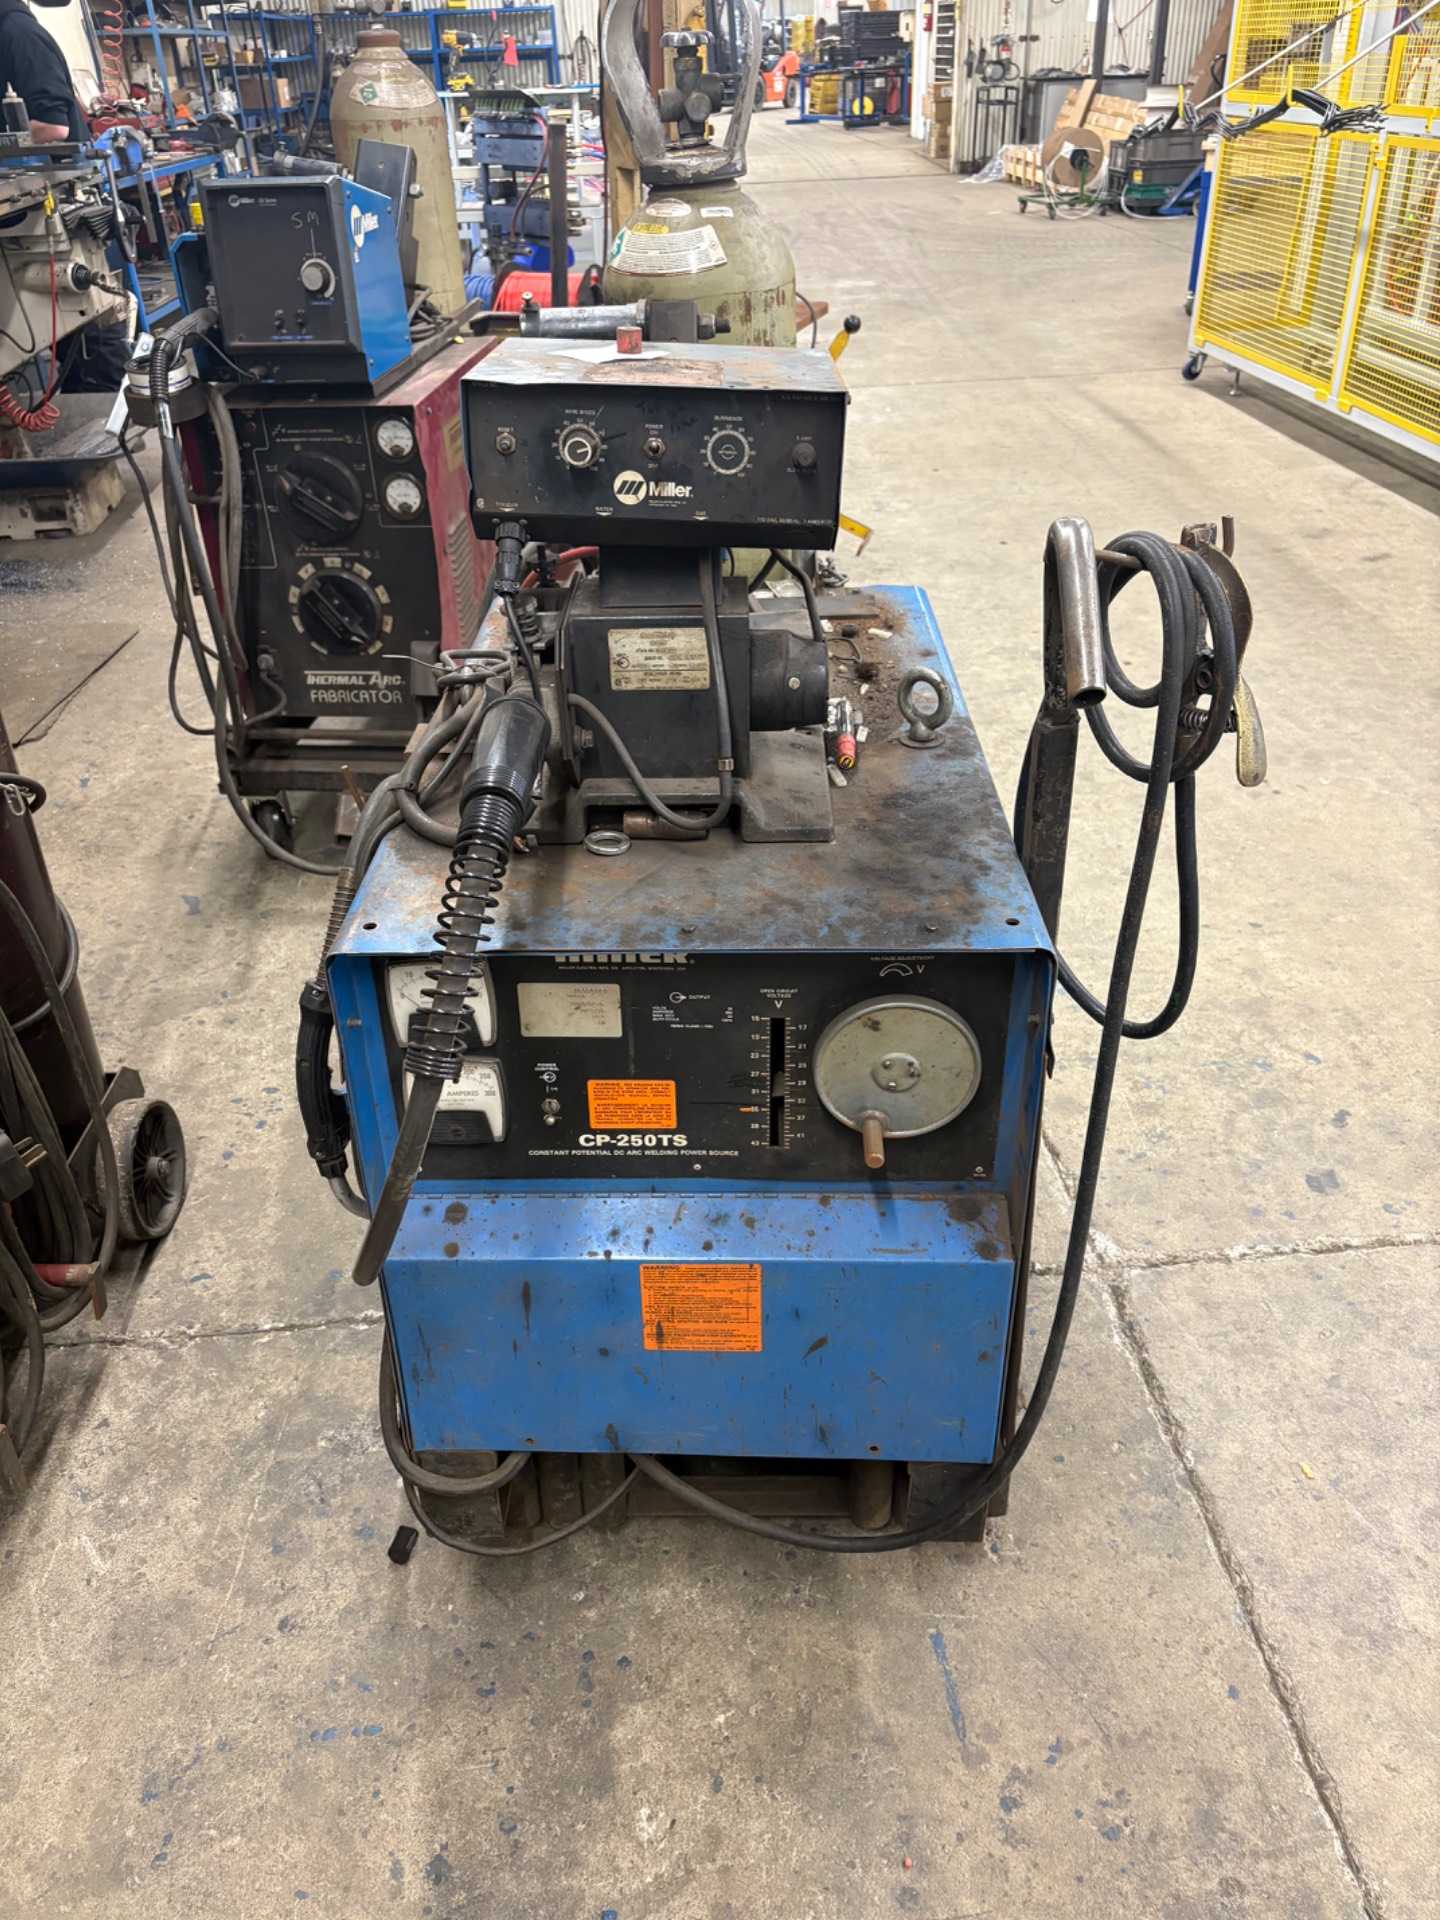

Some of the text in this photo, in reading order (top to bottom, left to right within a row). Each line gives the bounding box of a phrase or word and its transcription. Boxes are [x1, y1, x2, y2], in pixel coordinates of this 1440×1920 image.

[649, 481, 693, 497] Miller
[310, 690, 403, 703] FABRICATOR
[916, 965, 925, 974] V
[774, 999, 783, 1009] V
[578, 1134, 688, 1147] CP-250TS
